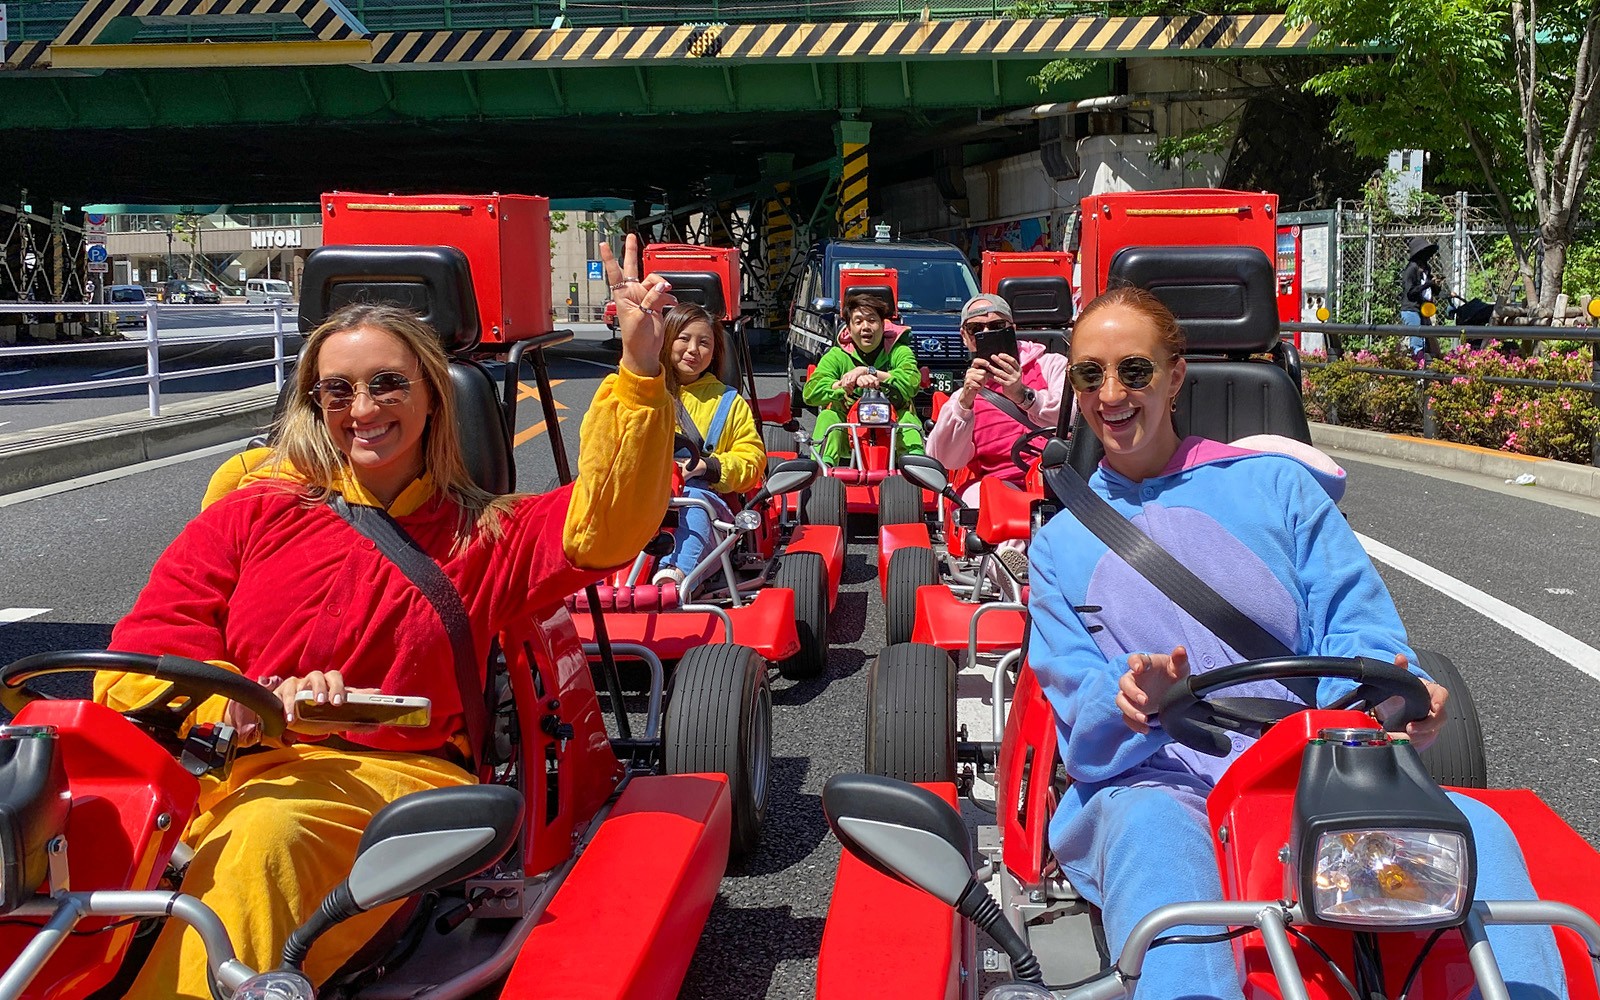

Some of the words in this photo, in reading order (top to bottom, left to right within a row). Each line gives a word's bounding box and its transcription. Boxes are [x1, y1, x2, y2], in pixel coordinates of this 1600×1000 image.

[251, 230, 301, 247] NITORI
[92, 249, 100, 261] P
[591, 262, 598, 270] P
